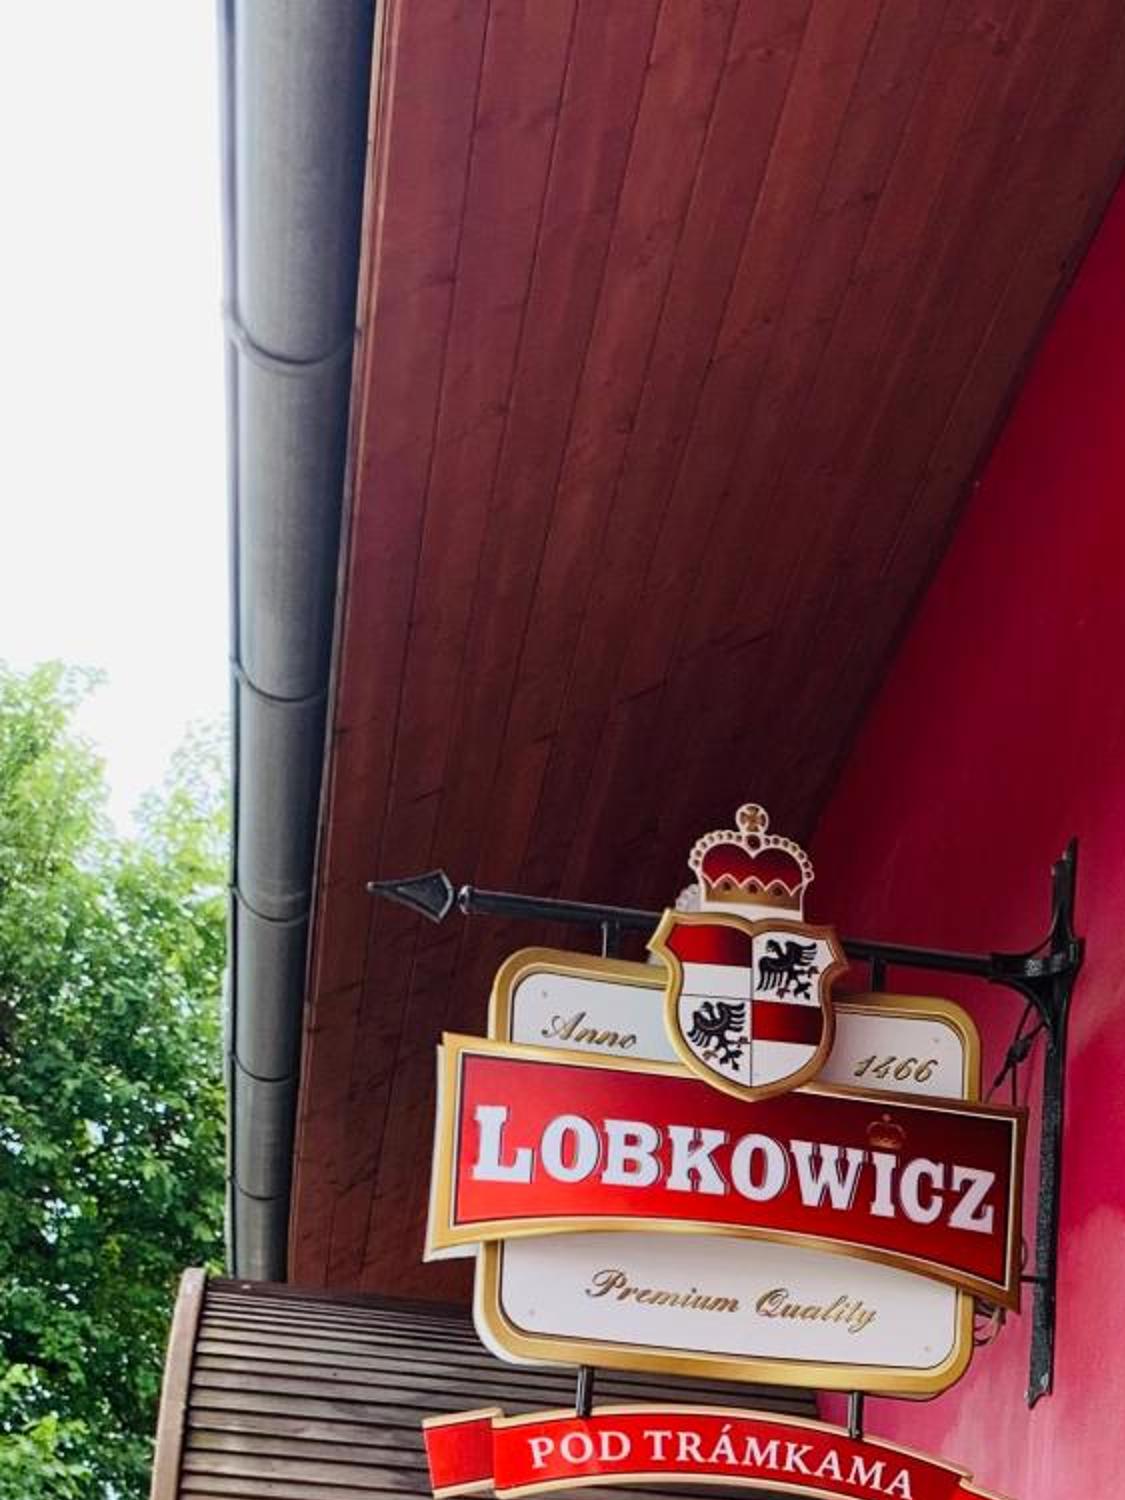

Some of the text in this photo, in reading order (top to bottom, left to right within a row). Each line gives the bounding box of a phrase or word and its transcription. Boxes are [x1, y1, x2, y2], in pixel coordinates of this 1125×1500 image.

[541, 1011, 939, 1083] Anno 1466
[471, 1104, 997, 1234] LOBKOWICZ
[584, 1268, 879, 1334] Premium Quality
[528, 1423, 914, 1500] POD TRÁMKAMA
